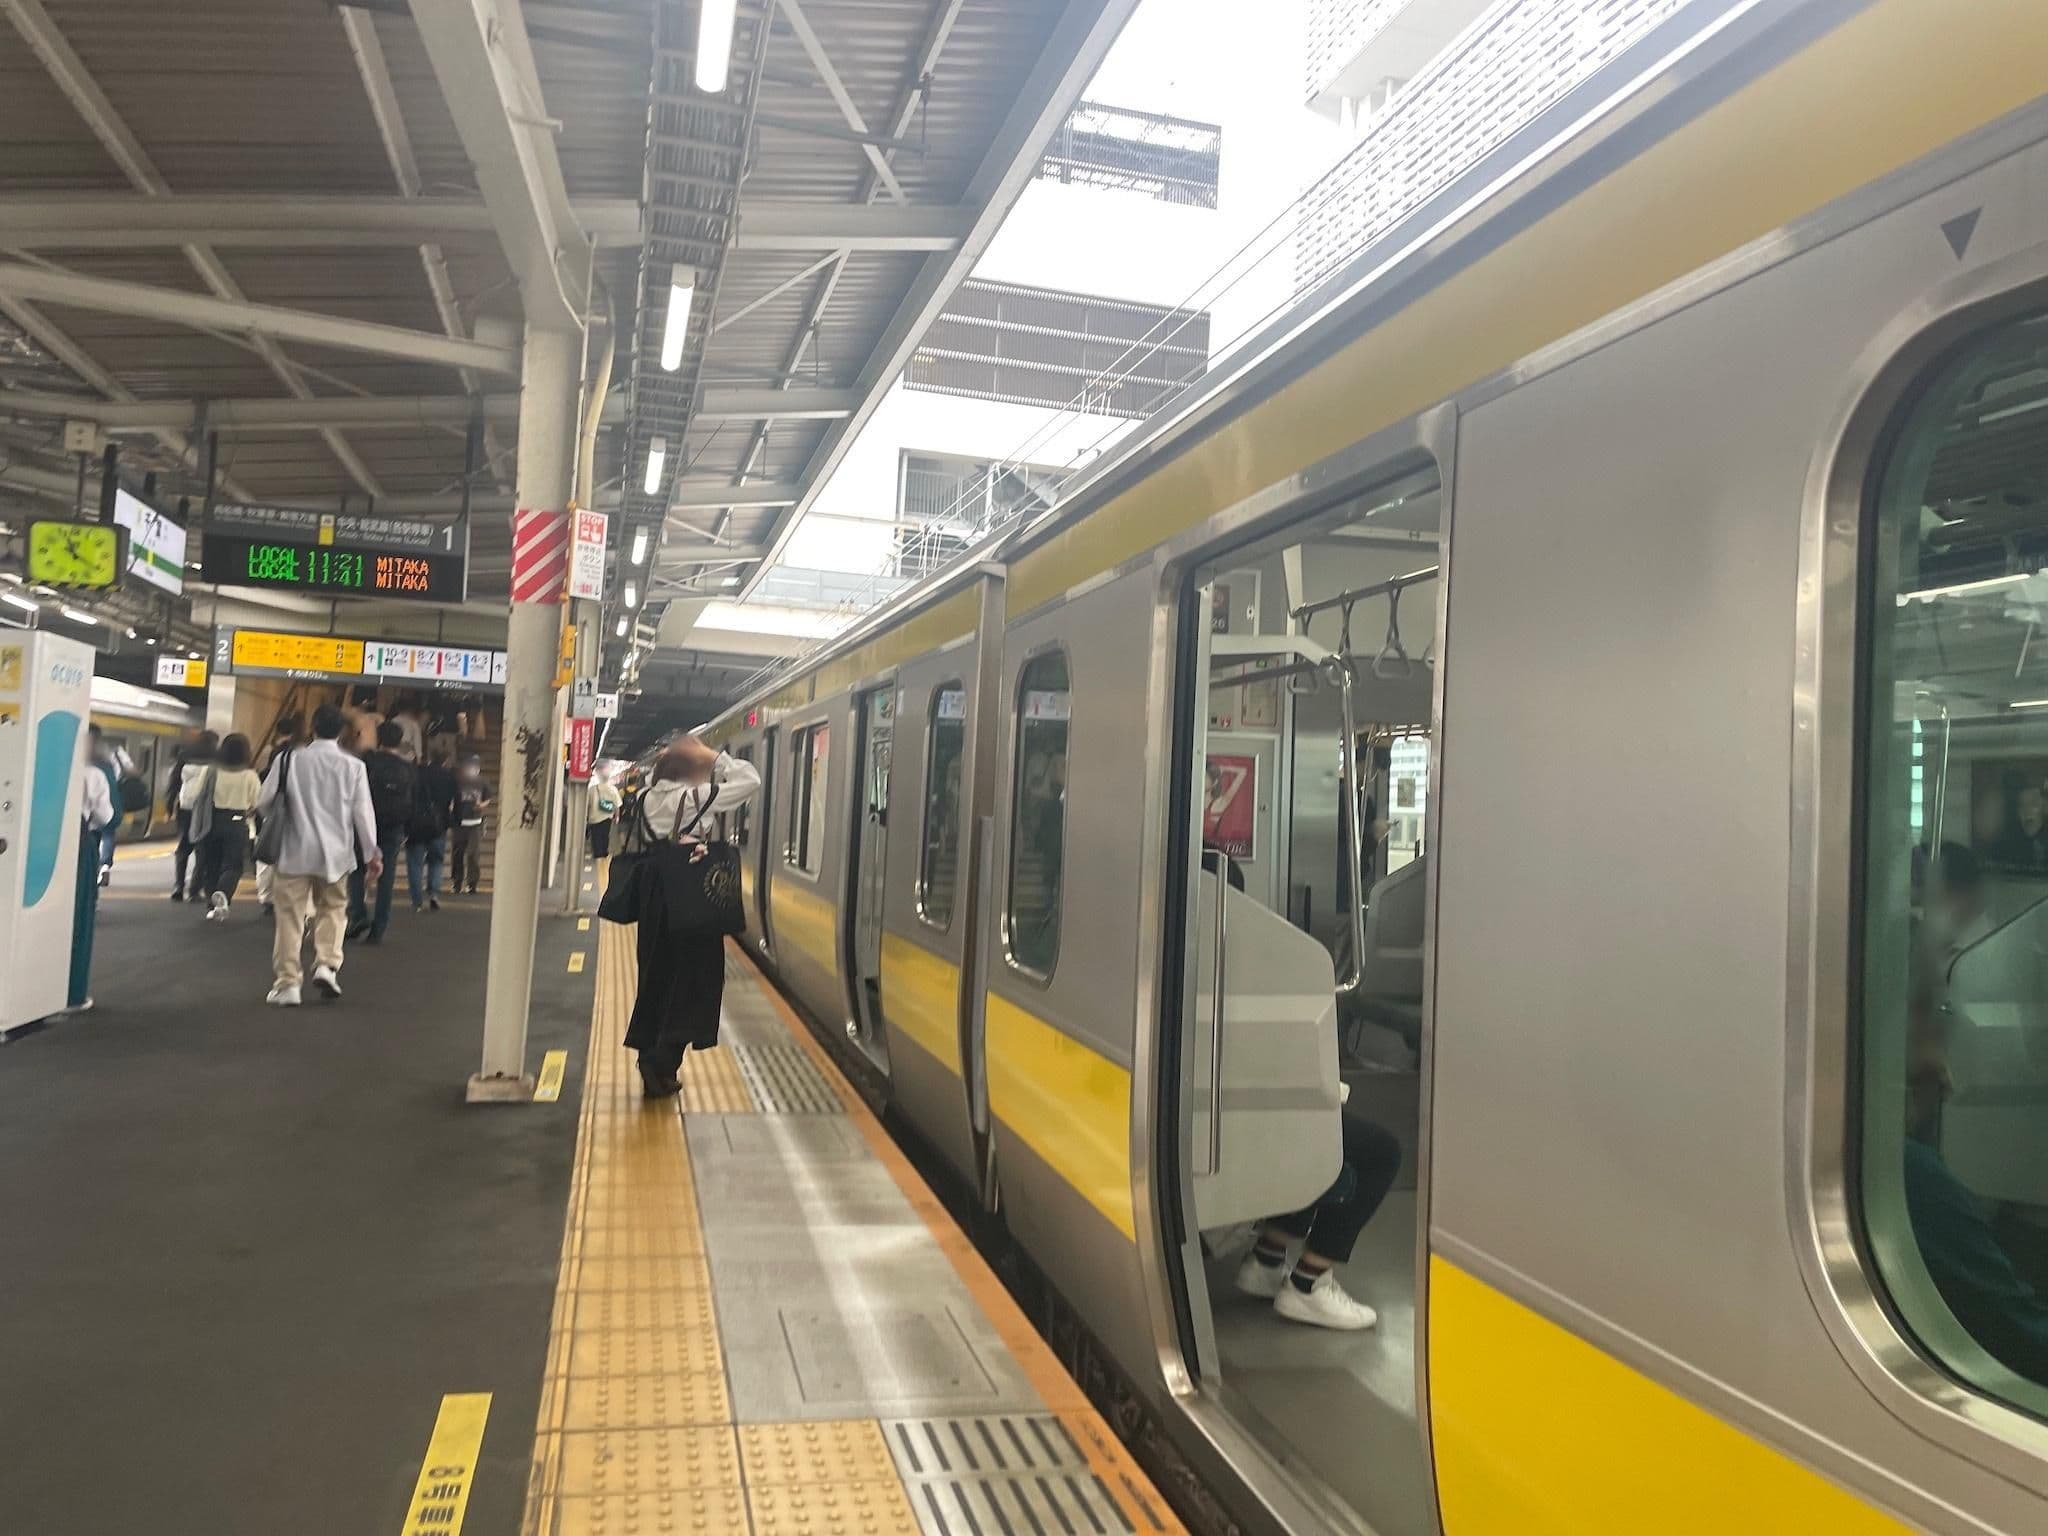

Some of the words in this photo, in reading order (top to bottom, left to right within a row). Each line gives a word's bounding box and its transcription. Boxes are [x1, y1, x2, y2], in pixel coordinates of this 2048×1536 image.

[580, 513, 604, 525] STOP
[442, 526, 453, 551] 1
[249, 544, 300, 566] LOCAL
[308, 550, 363, 571] 11:21
[376, 556, 430, 575] MITAKA
[248, 562, 300, 581] LOCAL
[308, 567, 362, 587] 11:41
[375, 573, 429, 592] MITAKA
[217, 639, 228, 655] 2
